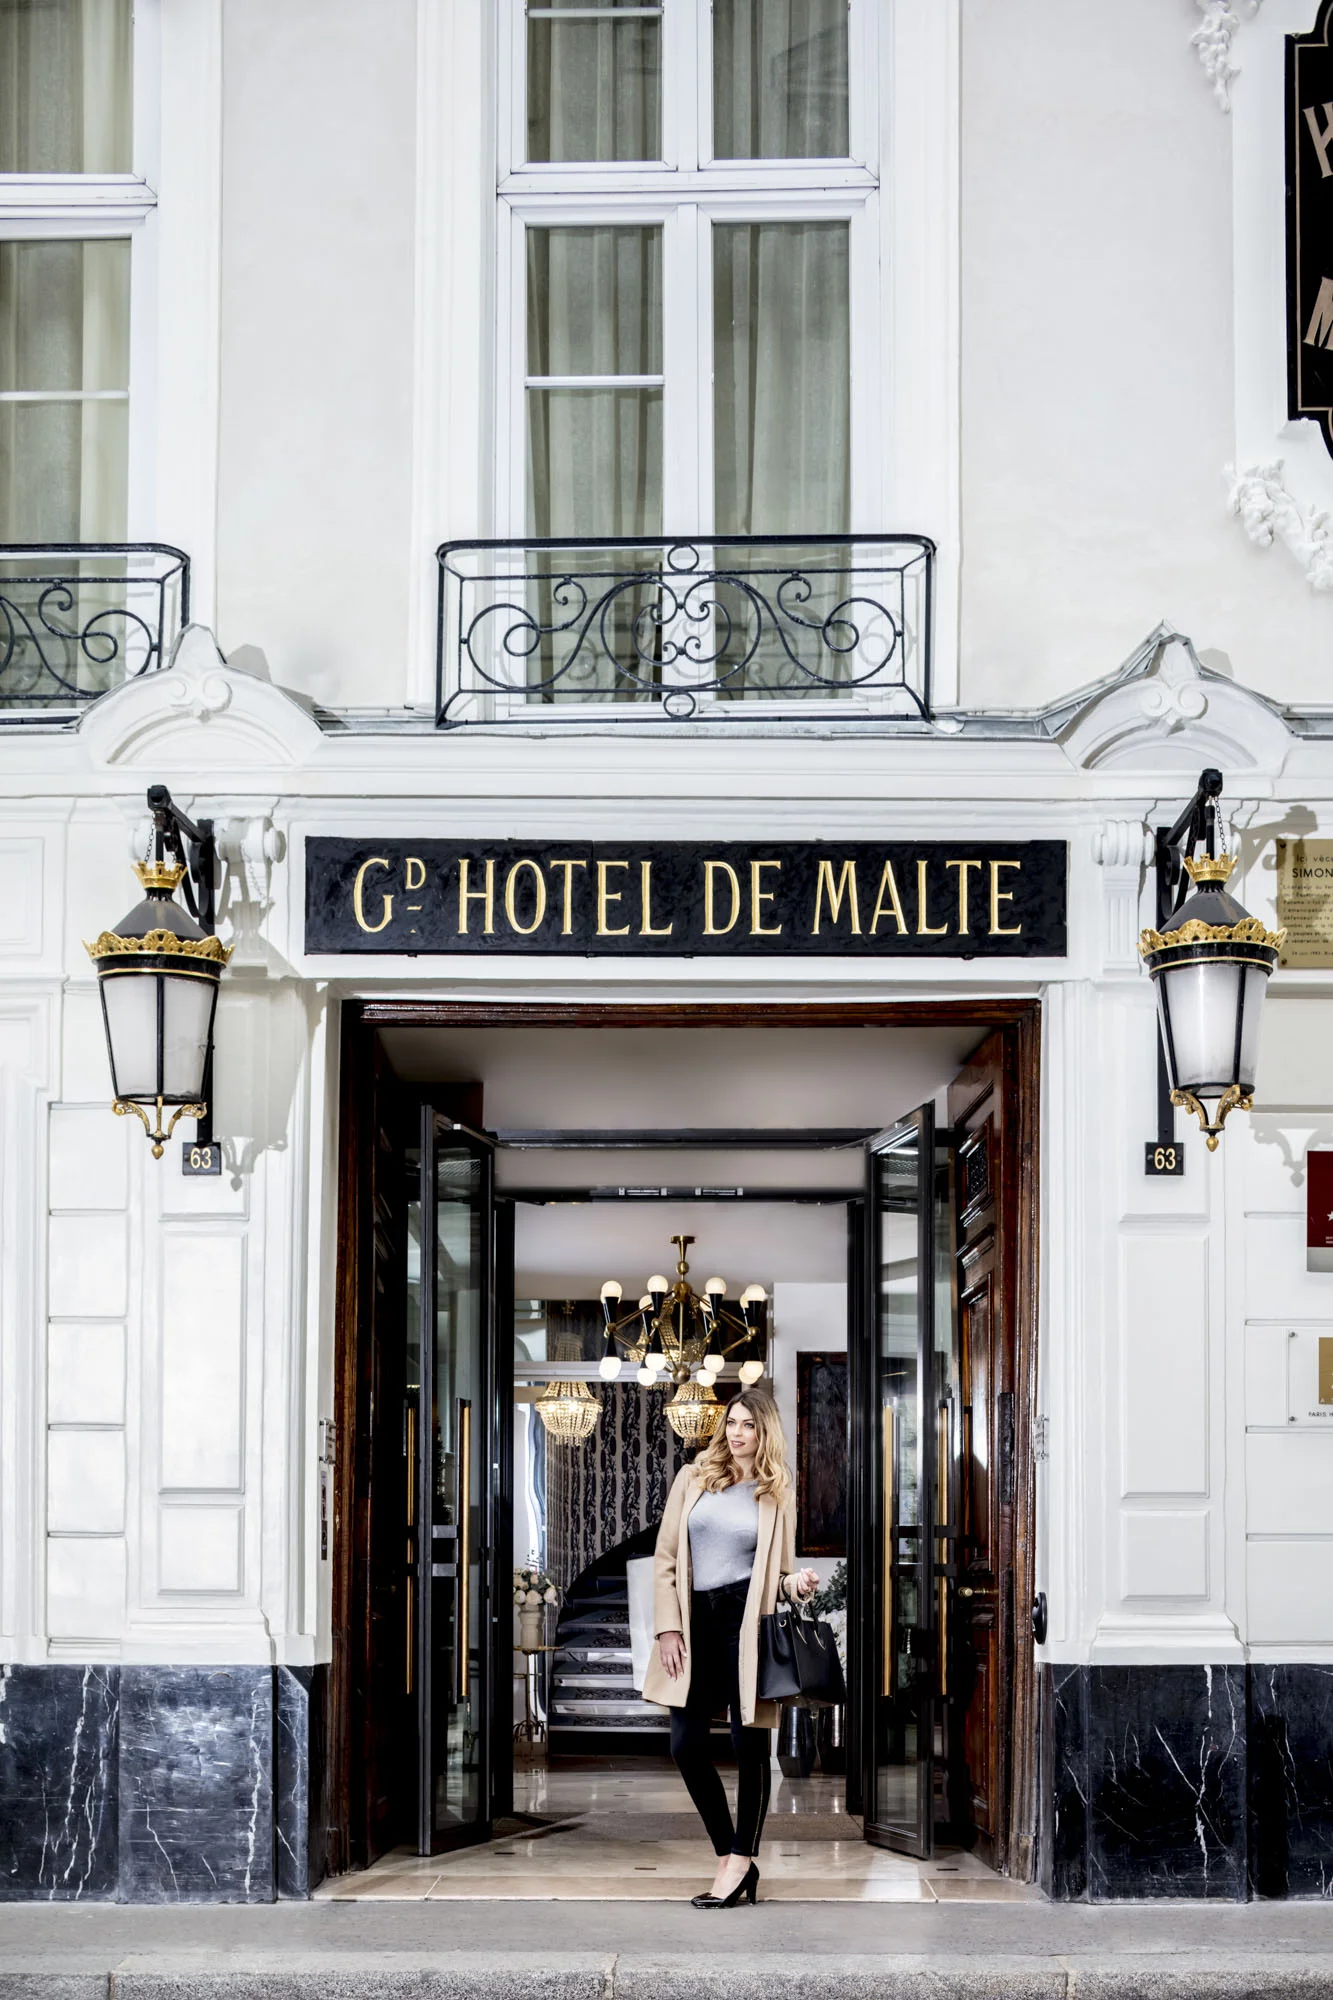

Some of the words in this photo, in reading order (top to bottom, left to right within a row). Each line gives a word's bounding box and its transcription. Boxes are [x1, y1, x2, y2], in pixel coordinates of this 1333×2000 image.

[1292, 868, 1333, 878] SIMON
[457, 859, 673, 935] HOTEL
[702, 861, 783, 935] DE
[811, 860, 1022, 935] MALTE
[190, 1147, 212, 1169] 63
[1154, 1147, 1176, 1170] 63
